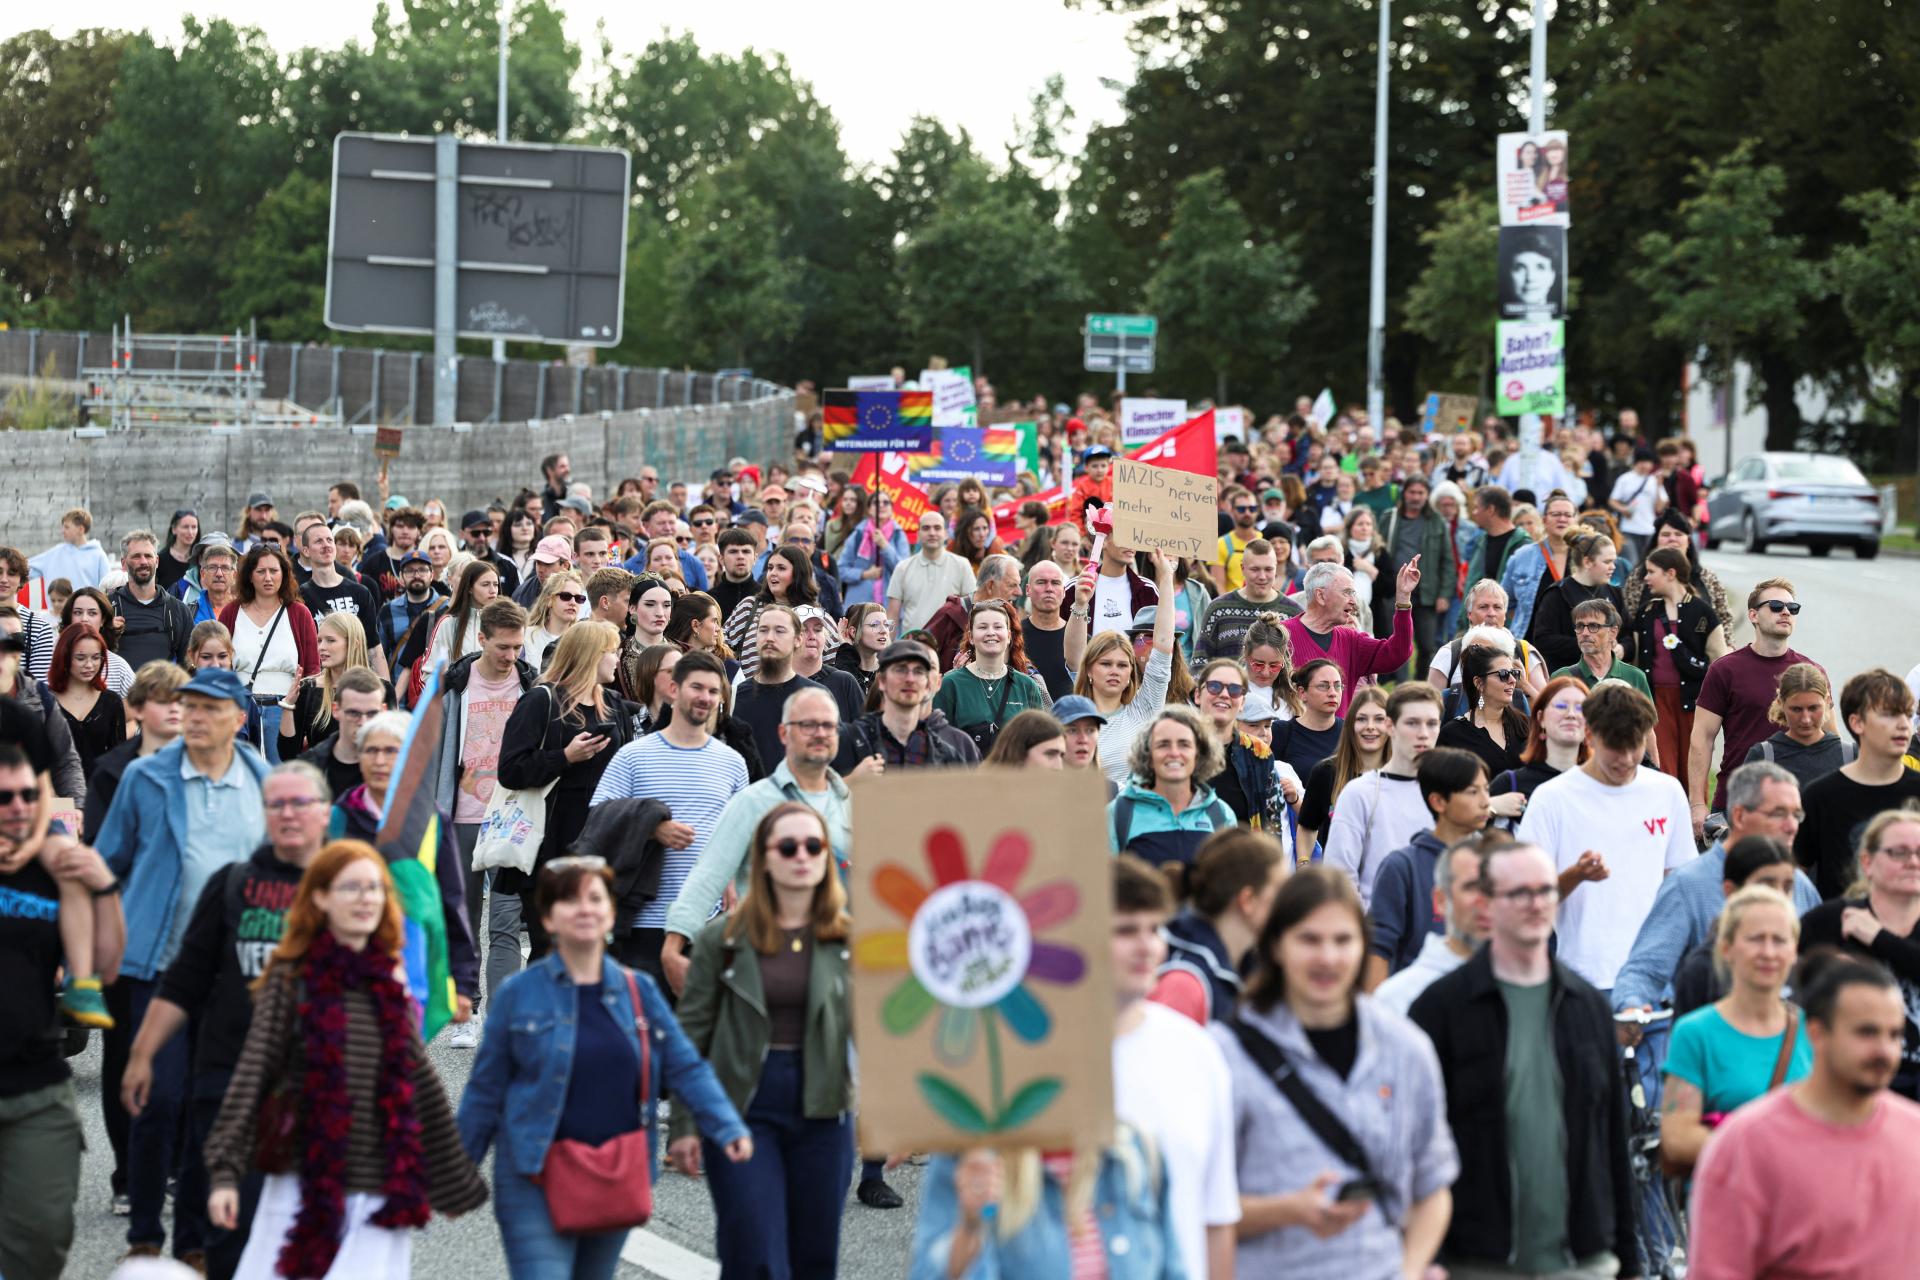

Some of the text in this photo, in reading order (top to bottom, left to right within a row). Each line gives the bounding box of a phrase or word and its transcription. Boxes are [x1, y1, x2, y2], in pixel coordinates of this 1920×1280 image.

[1133, 411, 1176, 422] Gerechter
[835, 439, 920, 449] MITEINANDER FÜR MV
[1119, 464, 1165, 489] NAZIS
[1168, 486, 1218, 506] nerven
[1119, 498, 1191, 522] mehr als
